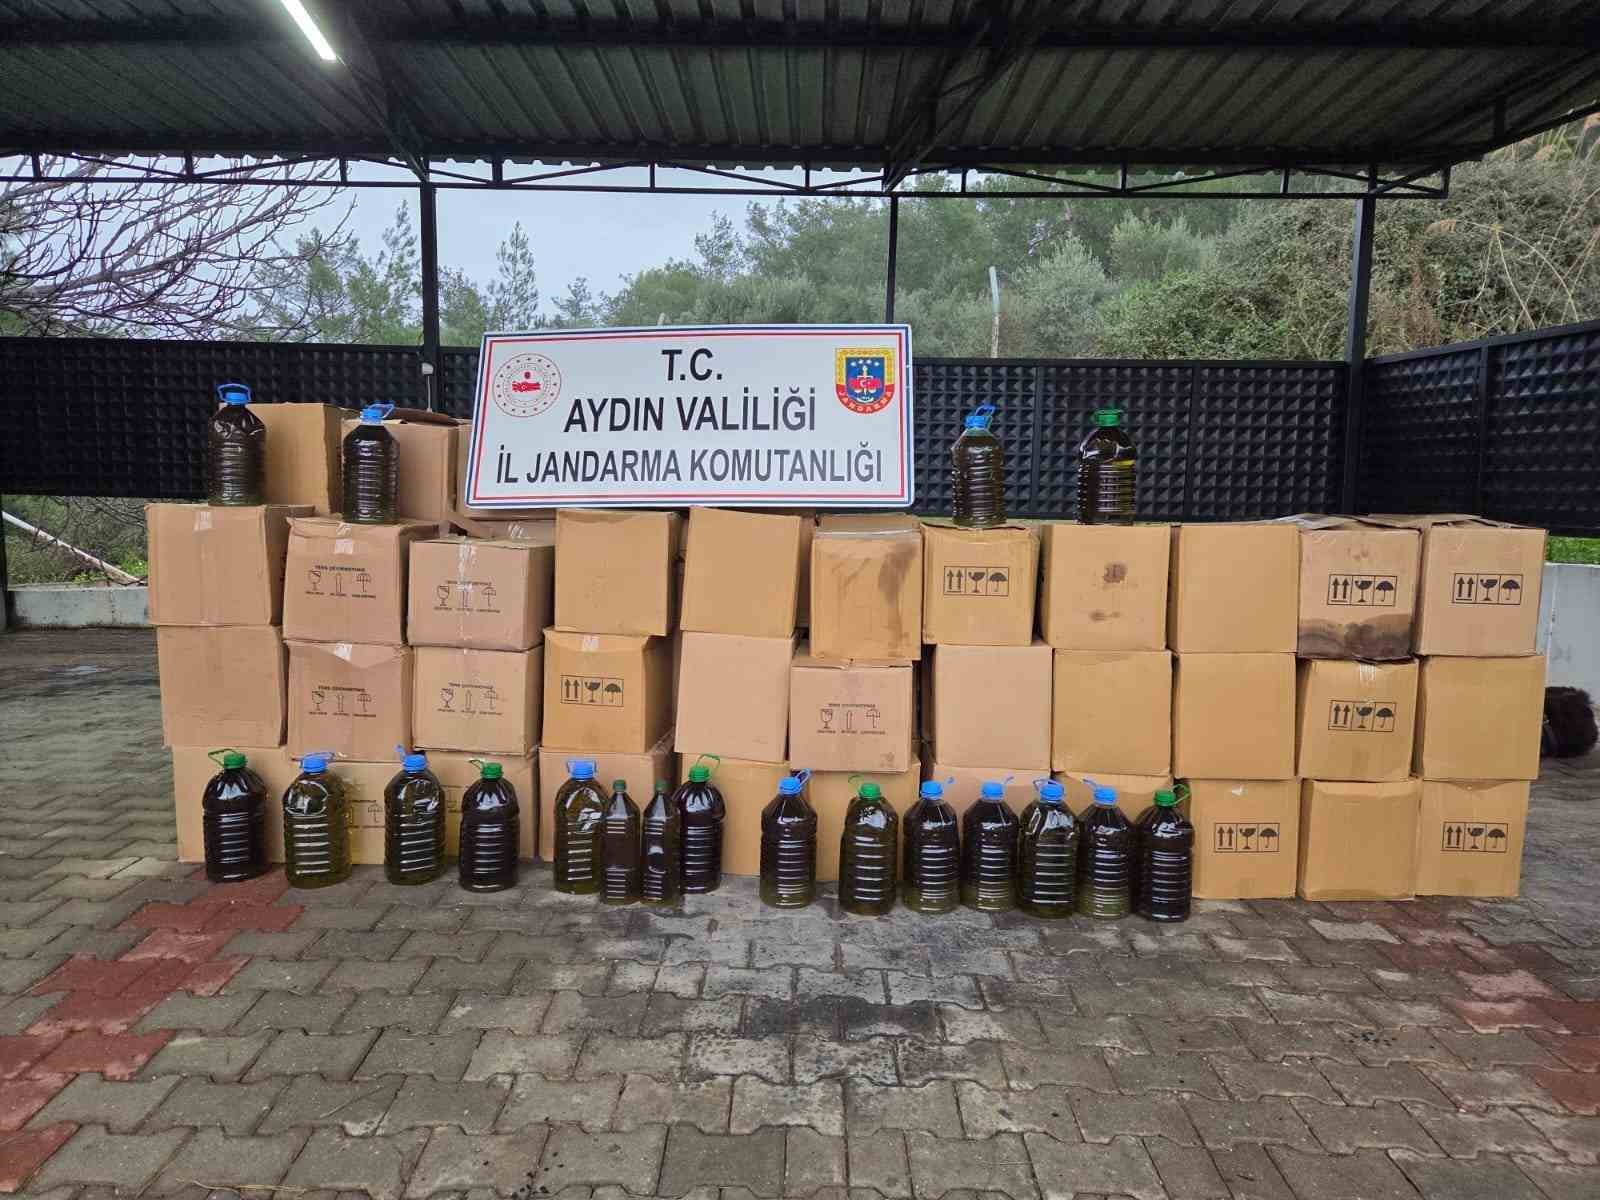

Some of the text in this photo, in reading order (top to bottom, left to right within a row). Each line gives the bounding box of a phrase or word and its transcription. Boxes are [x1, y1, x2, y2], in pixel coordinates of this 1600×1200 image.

[661, 347, 723, 382] T.C.
[563, 386, 816, 433] AYDIN VALİLİĞİ
[496, 441, 881, 484] İL JANDARMA KOMUTANLIĞI
